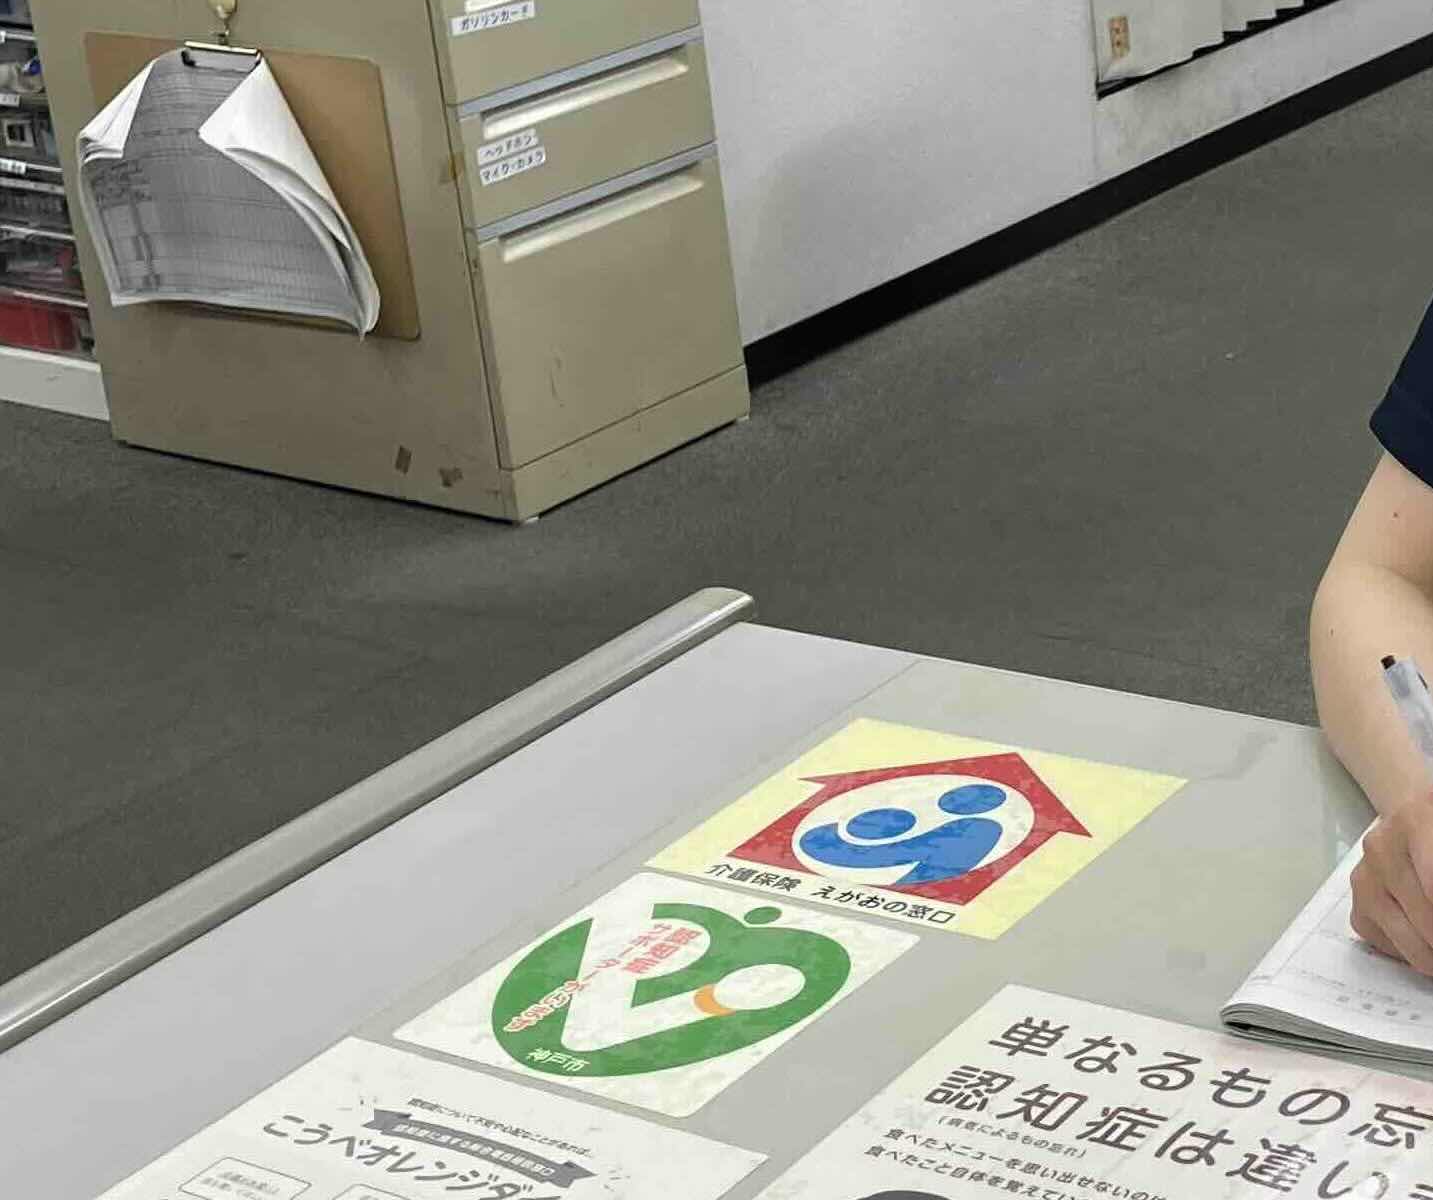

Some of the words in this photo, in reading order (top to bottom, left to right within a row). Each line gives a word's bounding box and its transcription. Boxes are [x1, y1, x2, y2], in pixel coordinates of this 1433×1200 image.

[704, 862, 803, 894] 介護保険
[811, 884, 956, 926] えがおの窓口
[525, 1047, 592, 1073] 神戸市
[263, 1115, 561, 1200] こうべオレンジダ
[884, 1128, 1167, 1200] 食べたメニューを思い出せないの
